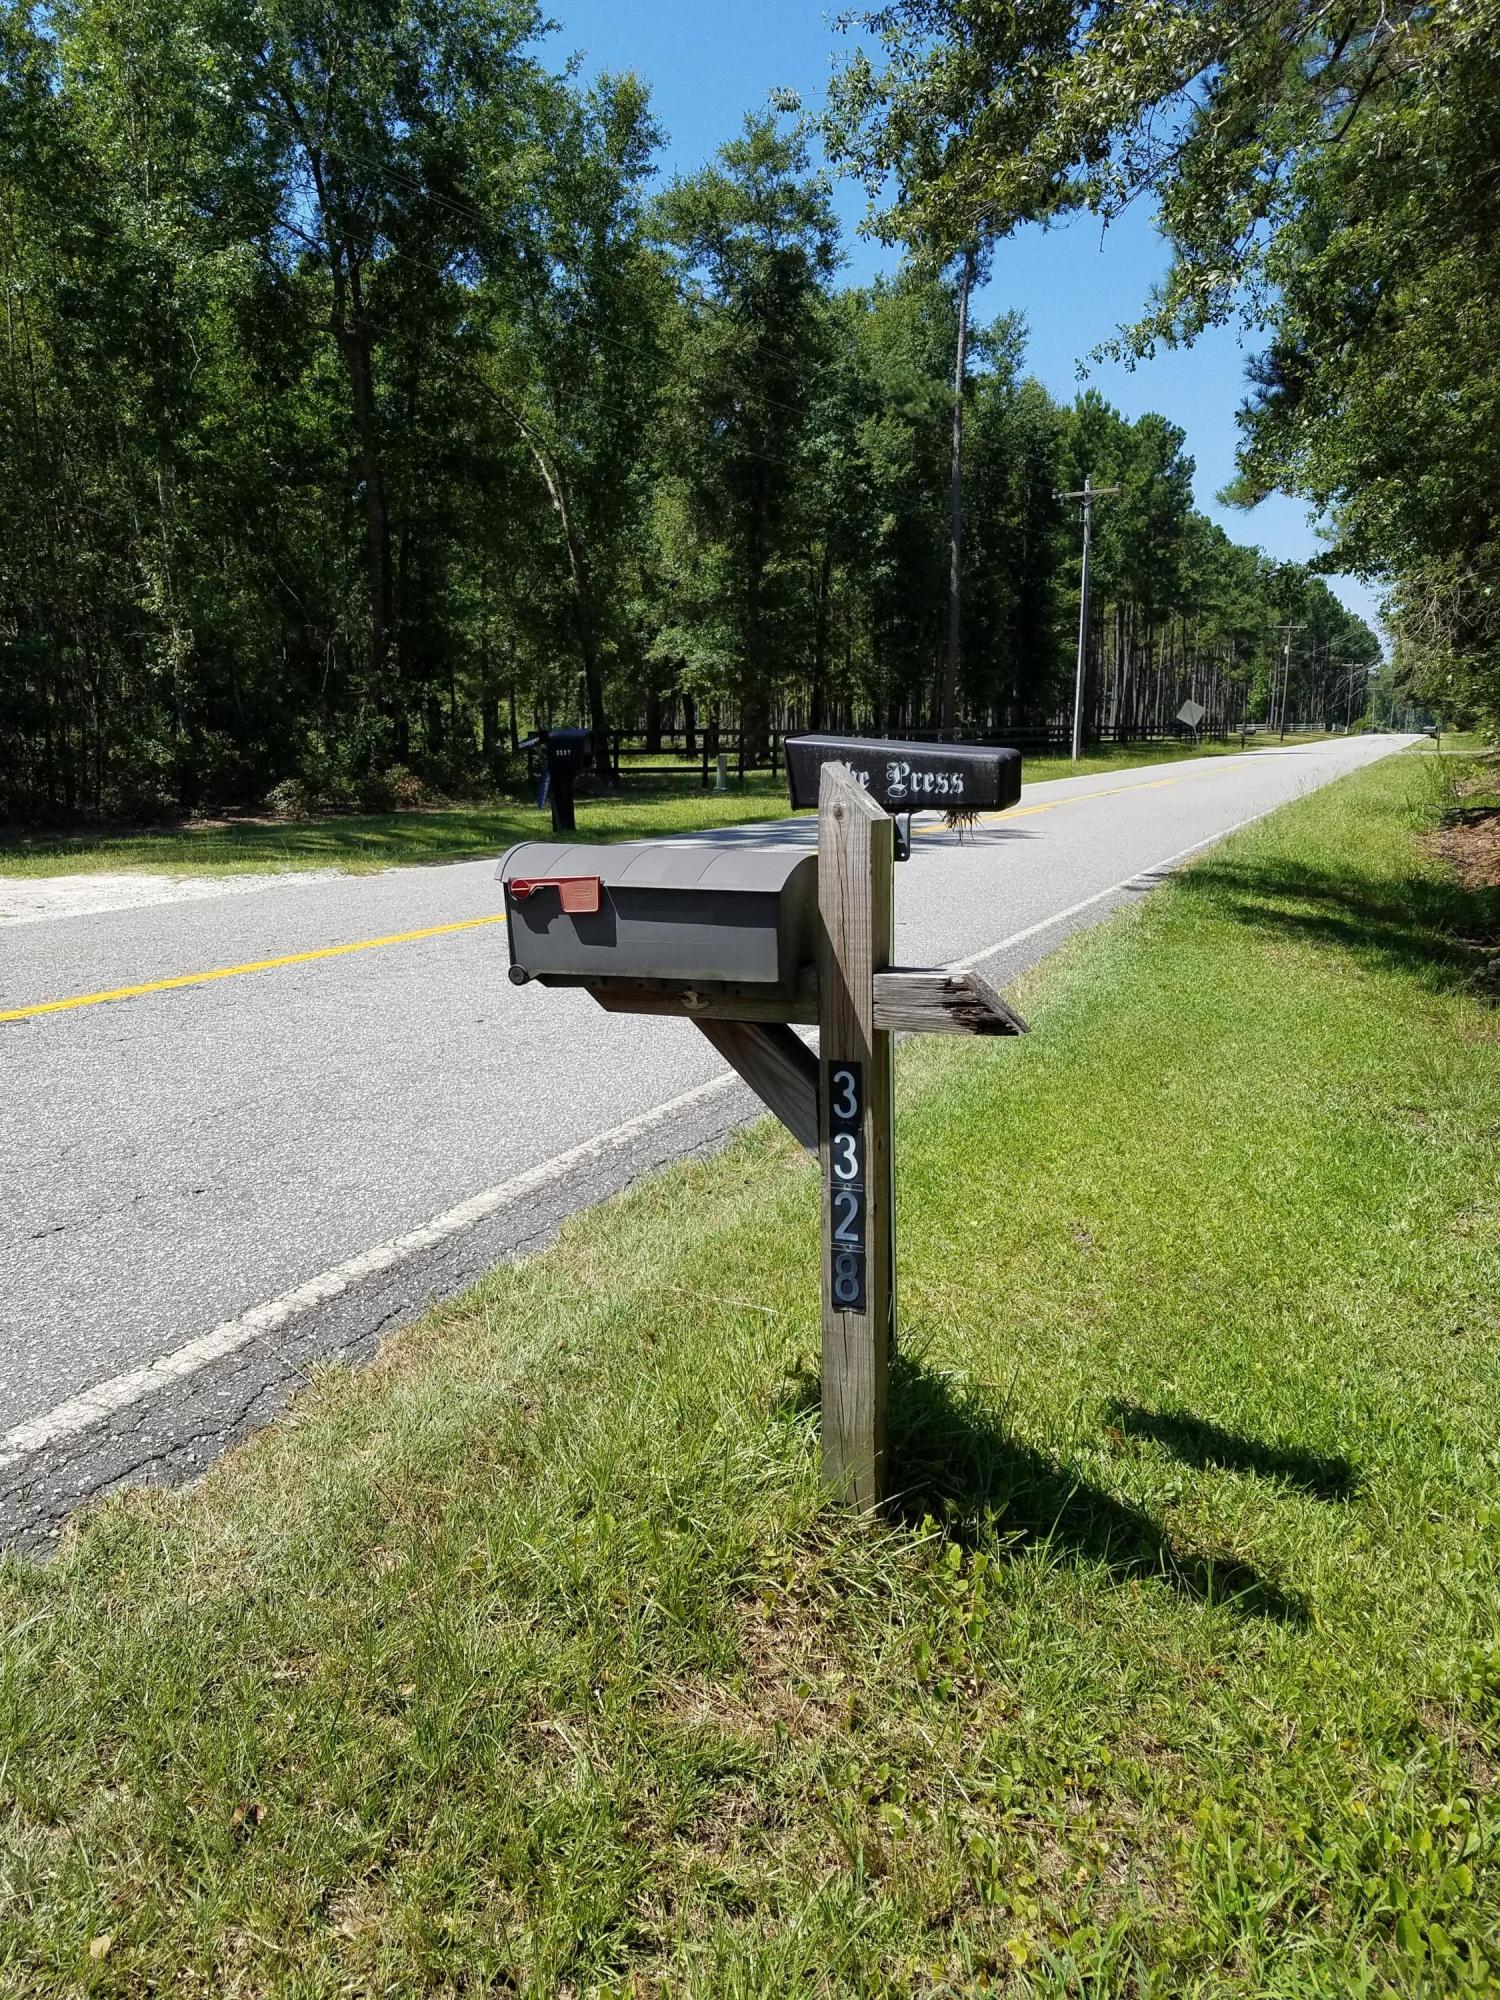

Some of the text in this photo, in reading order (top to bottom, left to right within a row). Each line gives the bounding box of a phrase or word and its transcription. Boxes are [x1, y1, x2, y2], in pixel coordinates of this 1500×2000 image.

[845, 761, 965, 798] he Press
[833, 1070, 860, 1303] 3328
